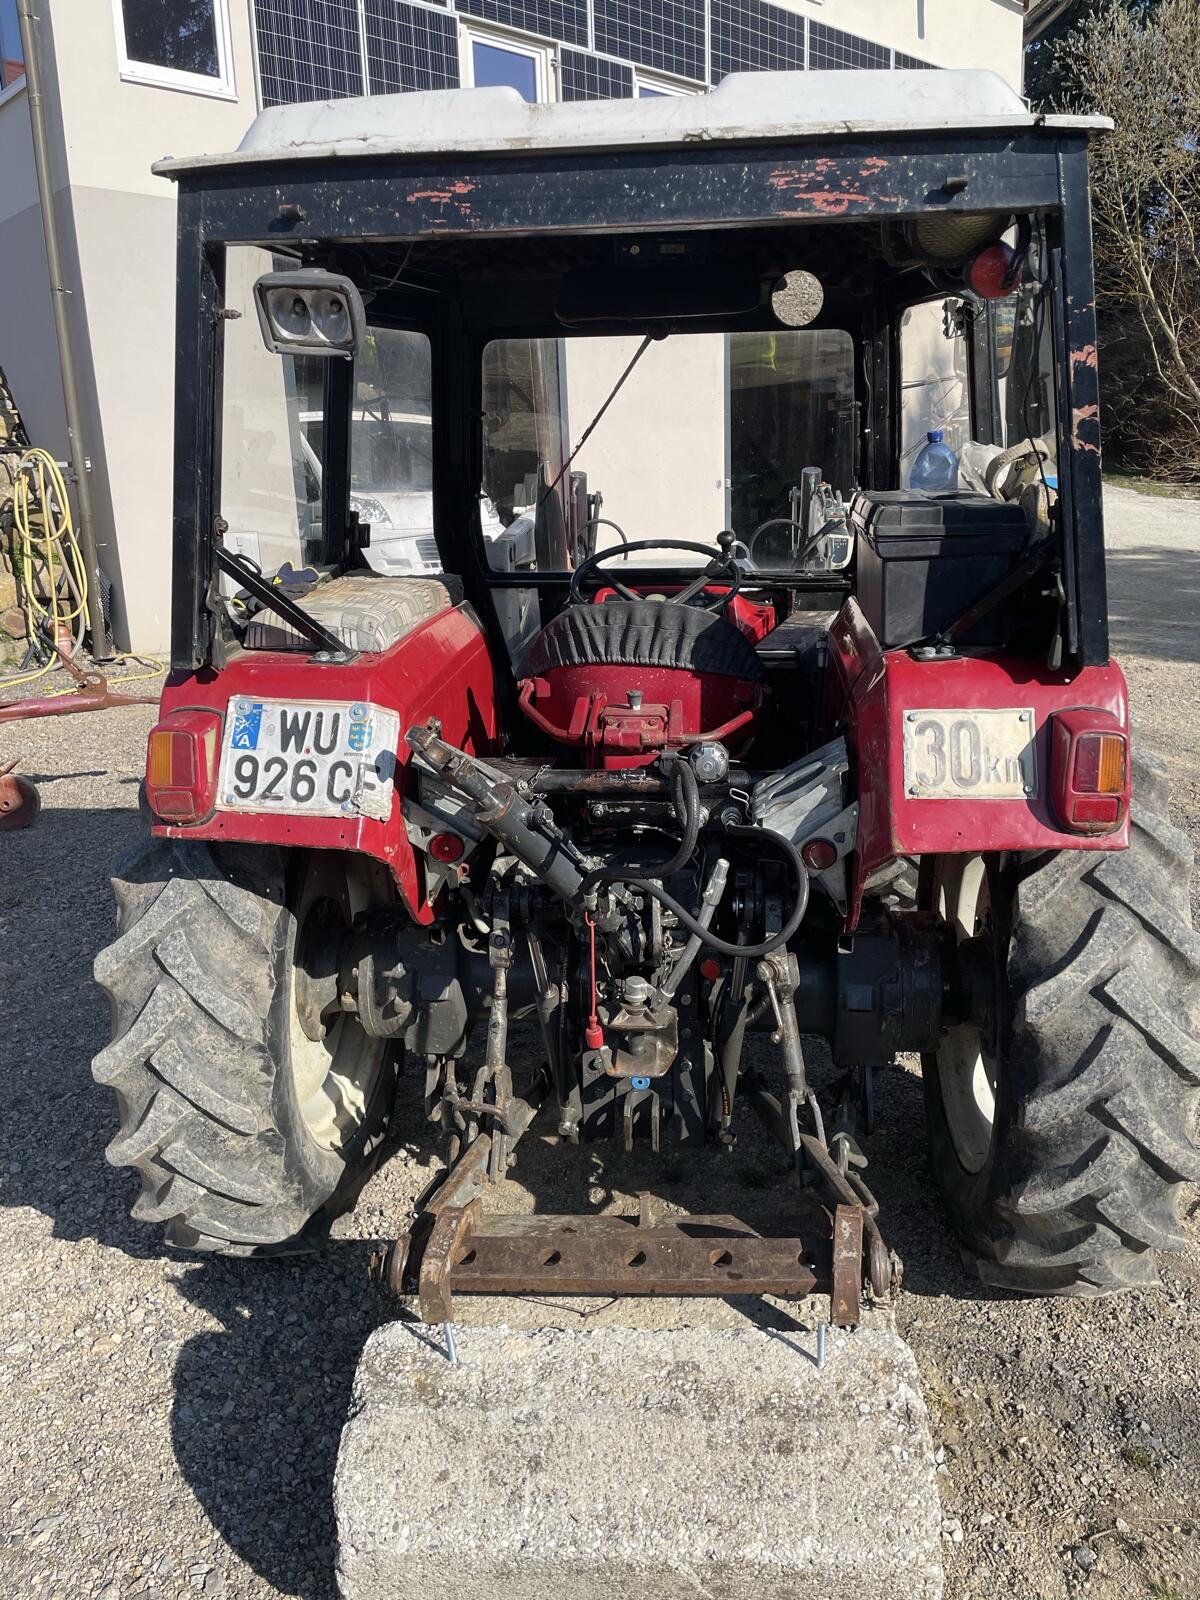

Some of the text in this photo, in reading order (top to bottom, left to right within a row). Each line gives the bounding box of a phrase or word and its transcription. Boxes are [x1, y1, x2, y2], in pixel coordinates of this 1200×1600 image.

[238, 734, 250, 747] A
[280, 709, 341, 755] WU
[233, 754, 317, 803] 926
